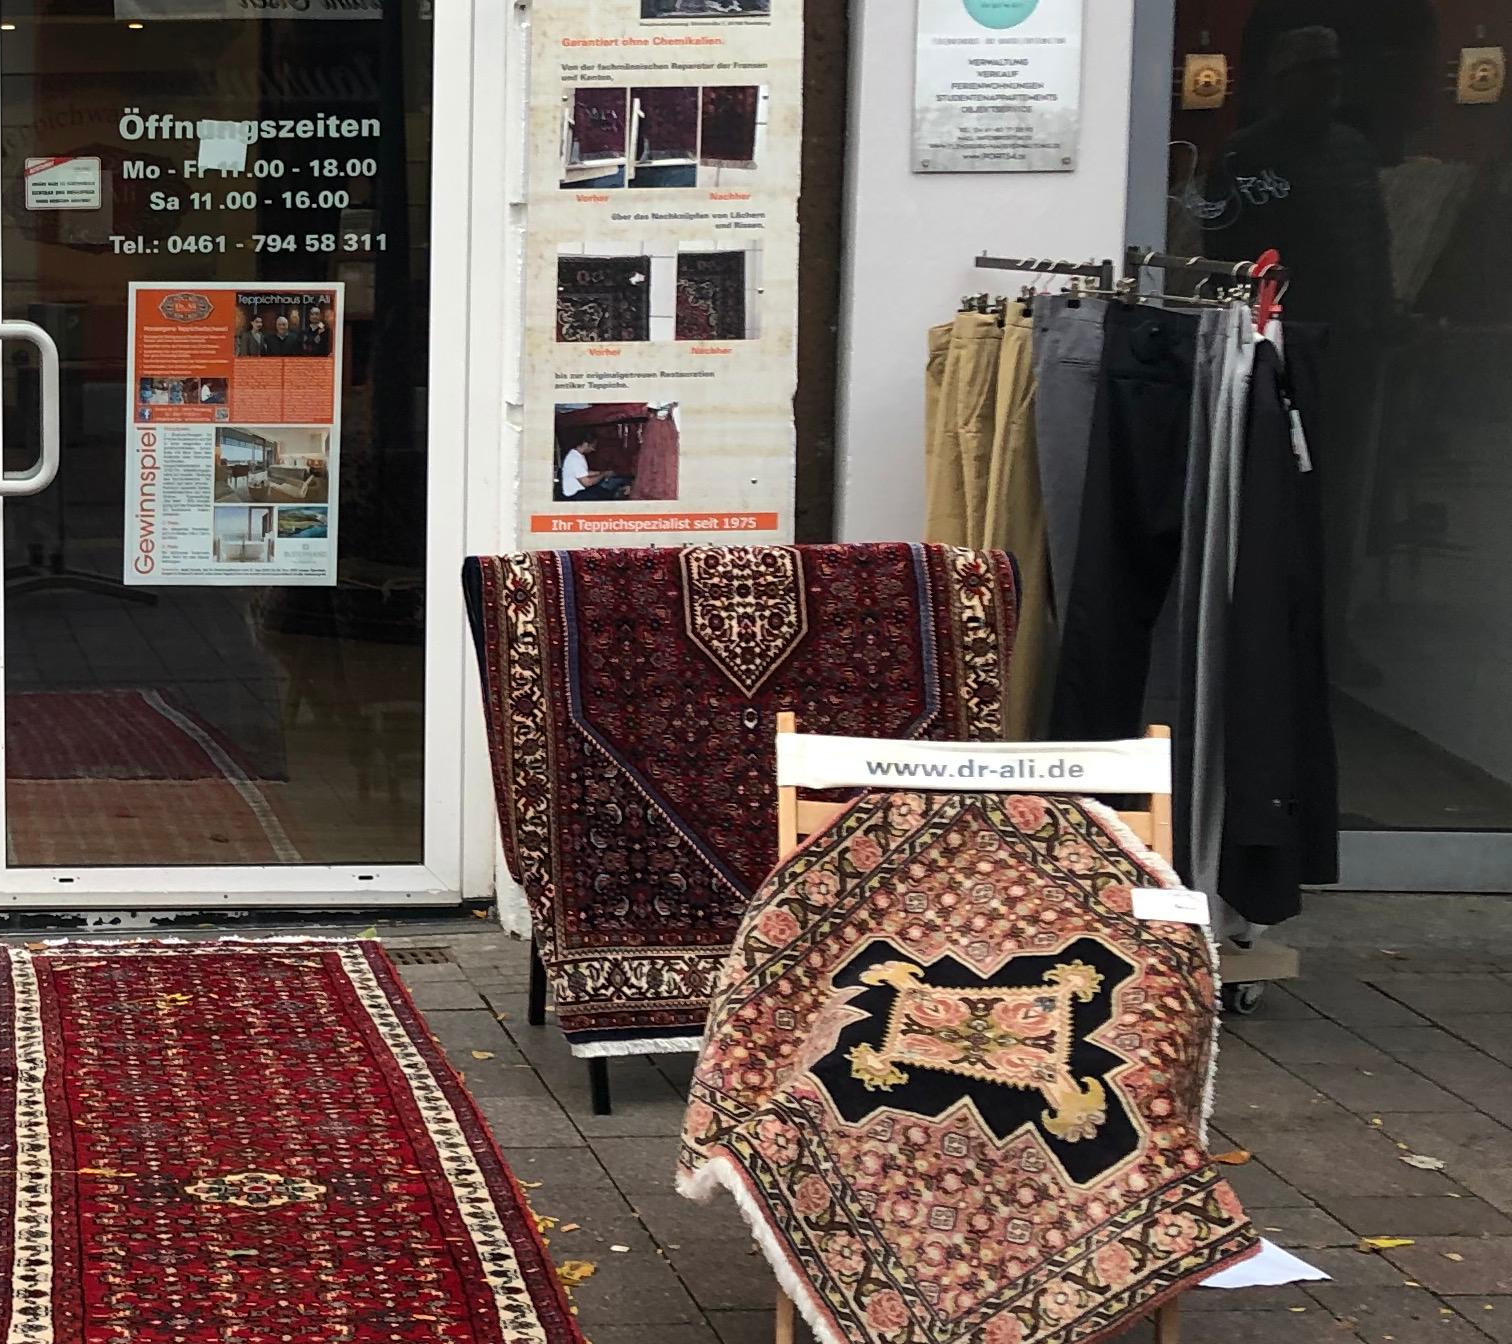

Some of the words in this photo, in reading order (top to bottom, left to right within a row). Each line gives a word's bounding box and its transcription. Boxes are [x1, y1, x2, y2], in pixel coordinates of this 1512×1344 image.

[561, 37, 619, 47] Garantiert
[622, 37, 650, 46] ohne
[122, 160, 161, 179] Mo
[309, 159, 378, 177] 18.00
[149, 191, 180, 211] Sa
[281, 190, 350, 208] 16.00
[109, 235, 160, 254] Tel.:
[167, 235, 226, 253] 0461
[252, 234, 297, 252] 794
[305, 234, 336, 251] 58
[343, 233, 387, 251] 311
[237, 294, 301, 305] Teppichhaus
[134, 426, 161, 575] Gewinnspiel
[551, 518, 574, 531] Ihr
[576, 518, 690, 532] Teppichspezialist
[693, 518, 719, 529] seit
[722, 517, 757, 529] 1975
[866, 759, 1086, 780] www.dr-ali.de
